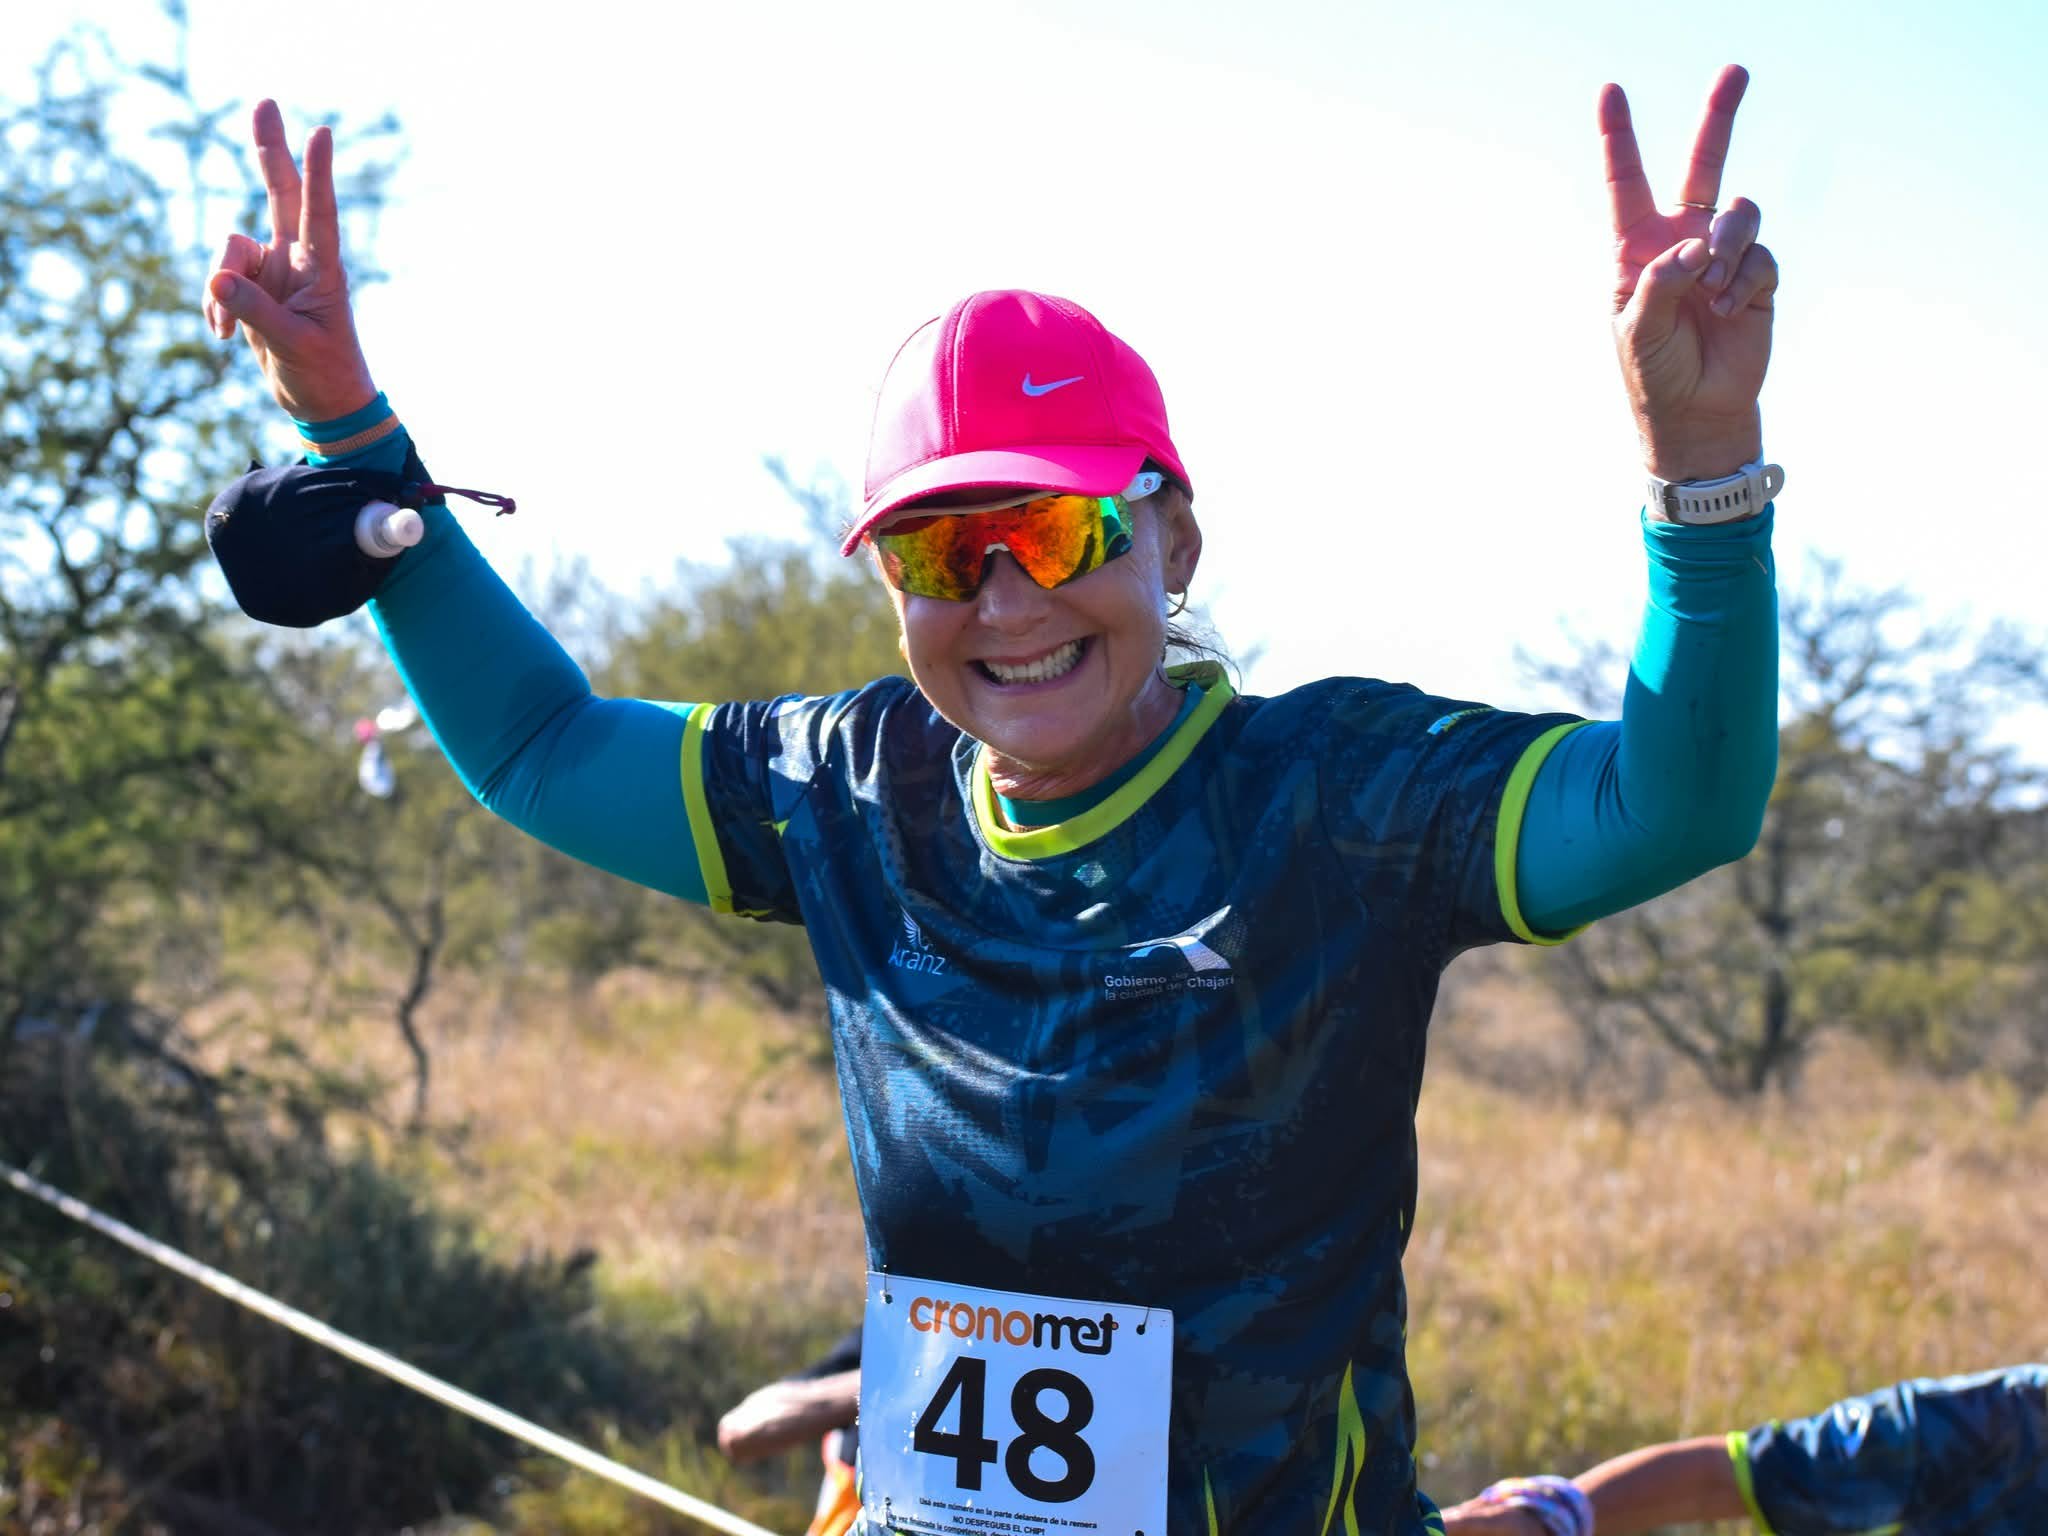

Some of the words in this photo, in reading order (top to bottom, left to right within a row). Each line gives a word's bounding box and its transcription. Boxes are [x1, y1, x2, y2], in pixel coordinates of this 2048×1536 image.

[1104, 975, 1167, 987] Gobierno
[1105, 989, 1117, 1001] la
[909, 1296, 1119, 1356] cronomet
[913, 1355, 1096, 1504] 48
[932, 1501, 947, 1509] este
[948, 1502, 975, 1513] número
[986, 1507, 993, 1516] la
[993, 1510, 1012, 1518] parte
[1014, 1512, 1048, 1524] delantera
[1050, 1517, 1060, 1525] de
[1061, 1518, 1068, 1526] la
[1069, 1520, 1098, 1529] remera
[953, 1516, 964, 1524] NO
[965, 1517, 1011, 1530] DESPEGUES
[1013, 1524, 1022, 1533] EL
